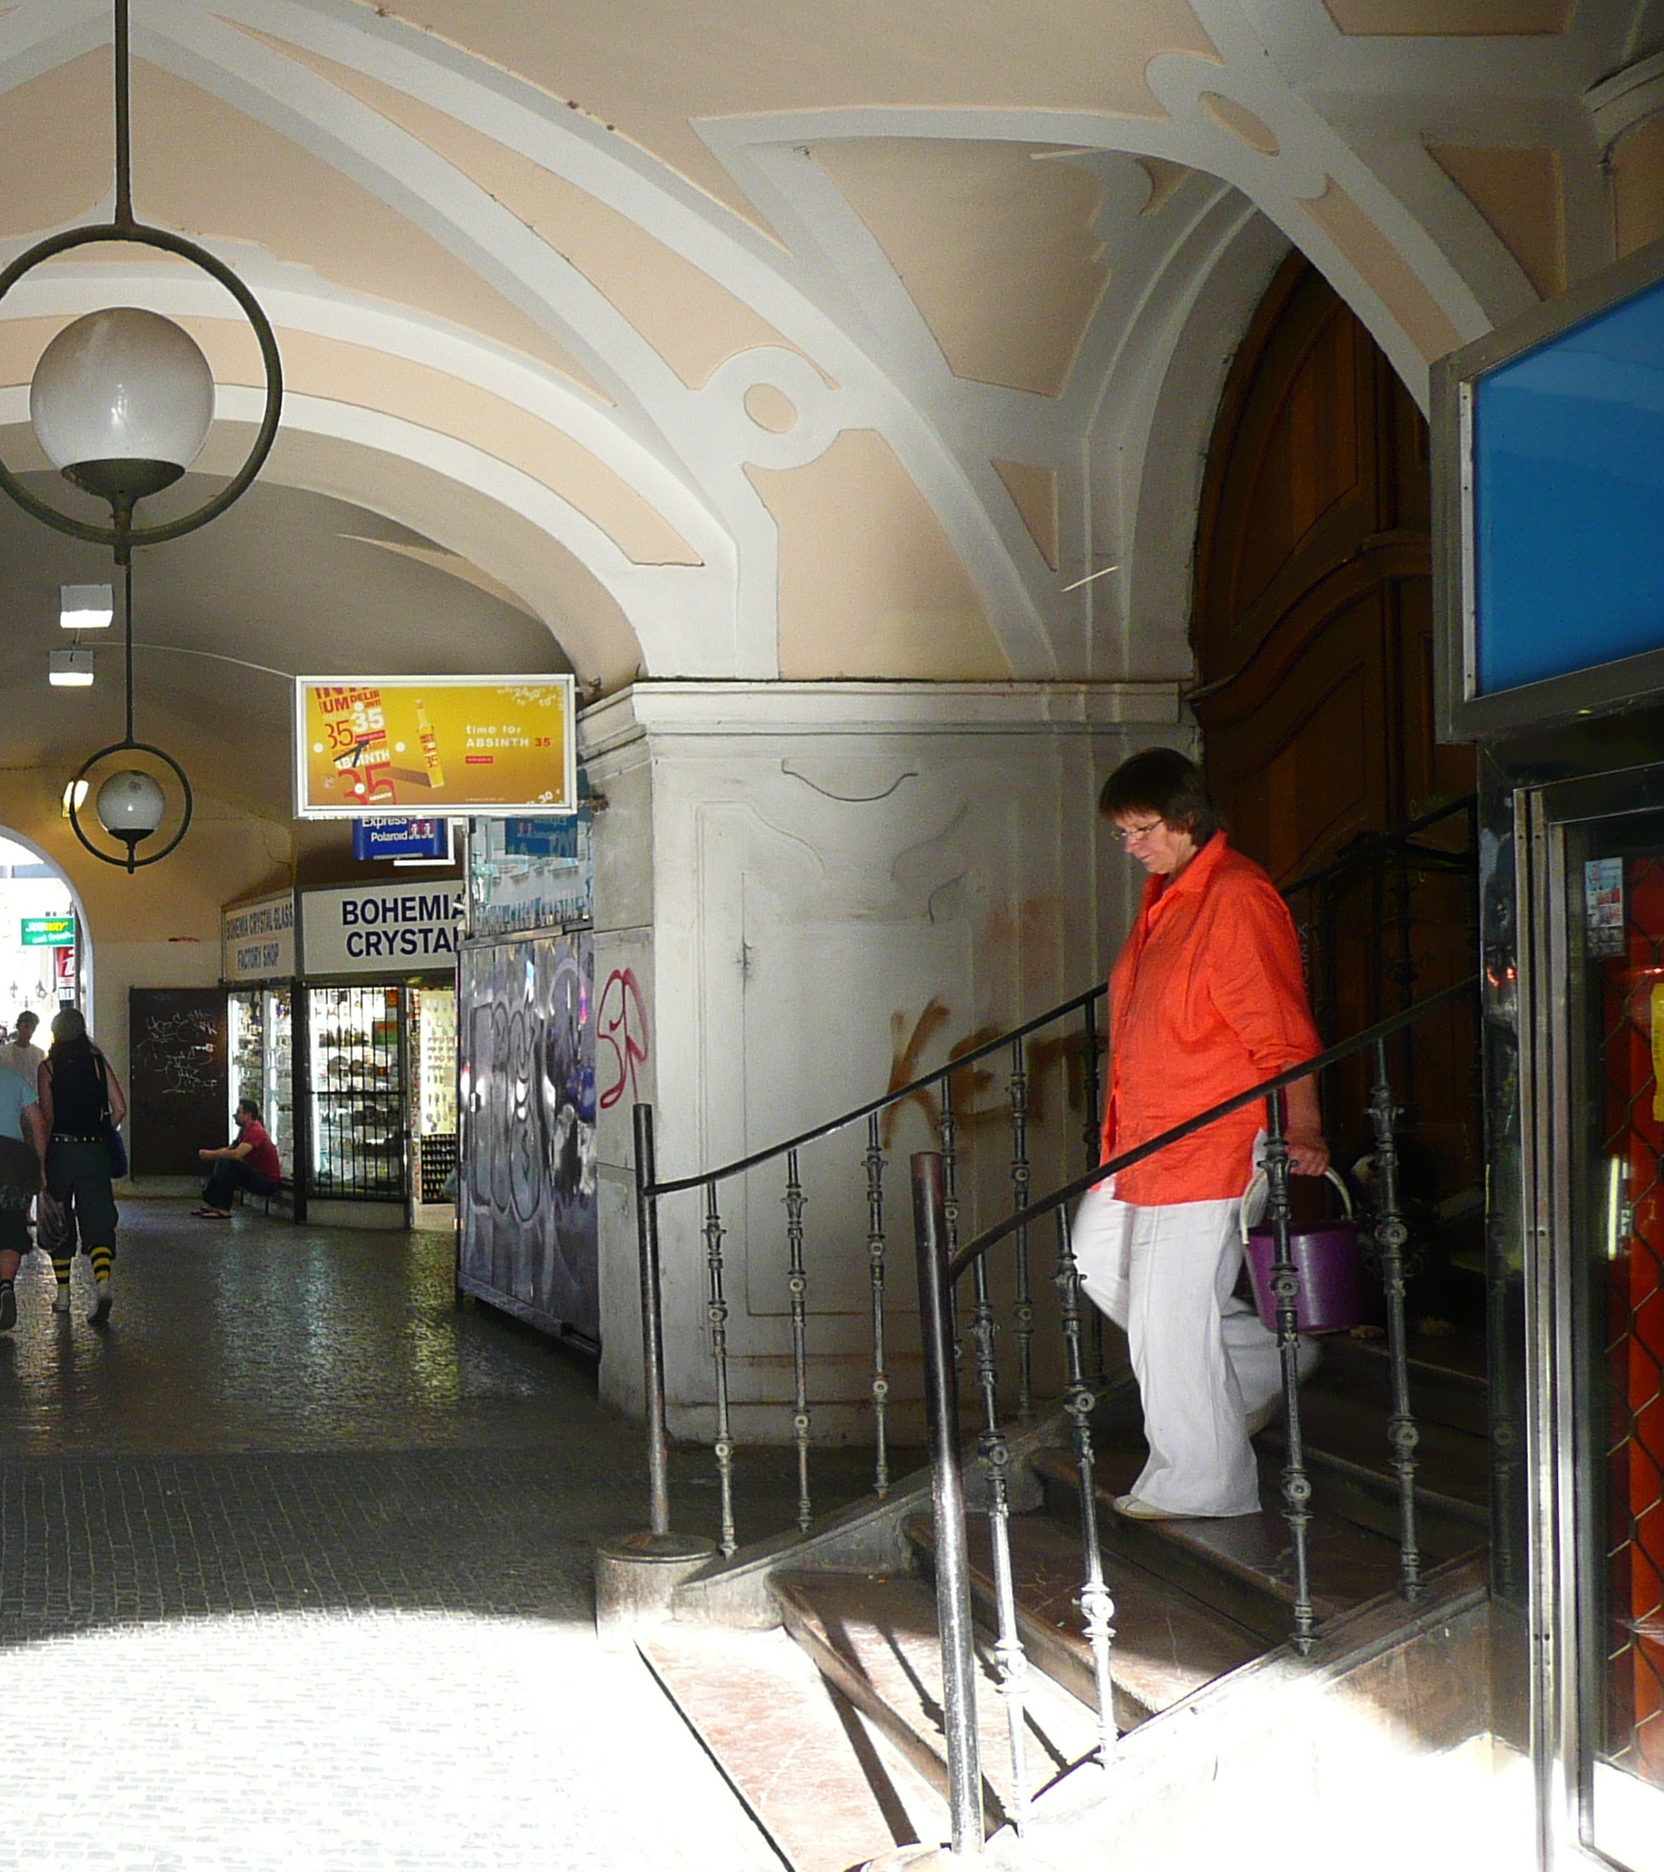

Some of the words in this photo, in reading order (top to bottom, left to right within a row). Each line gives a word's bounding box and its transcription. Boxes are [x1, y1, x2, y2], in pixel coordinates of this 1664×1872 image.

[351, 708, 385, 732] 35
[466, 725, 497, 735] time
[502, 725, 522, 735] for
[466, 738, 530, 748] ABSINTH
[534, 737, 551, 748] 35
[362, 816, 408, 829] Express
[371, 830, 408, 843] Polaroid
